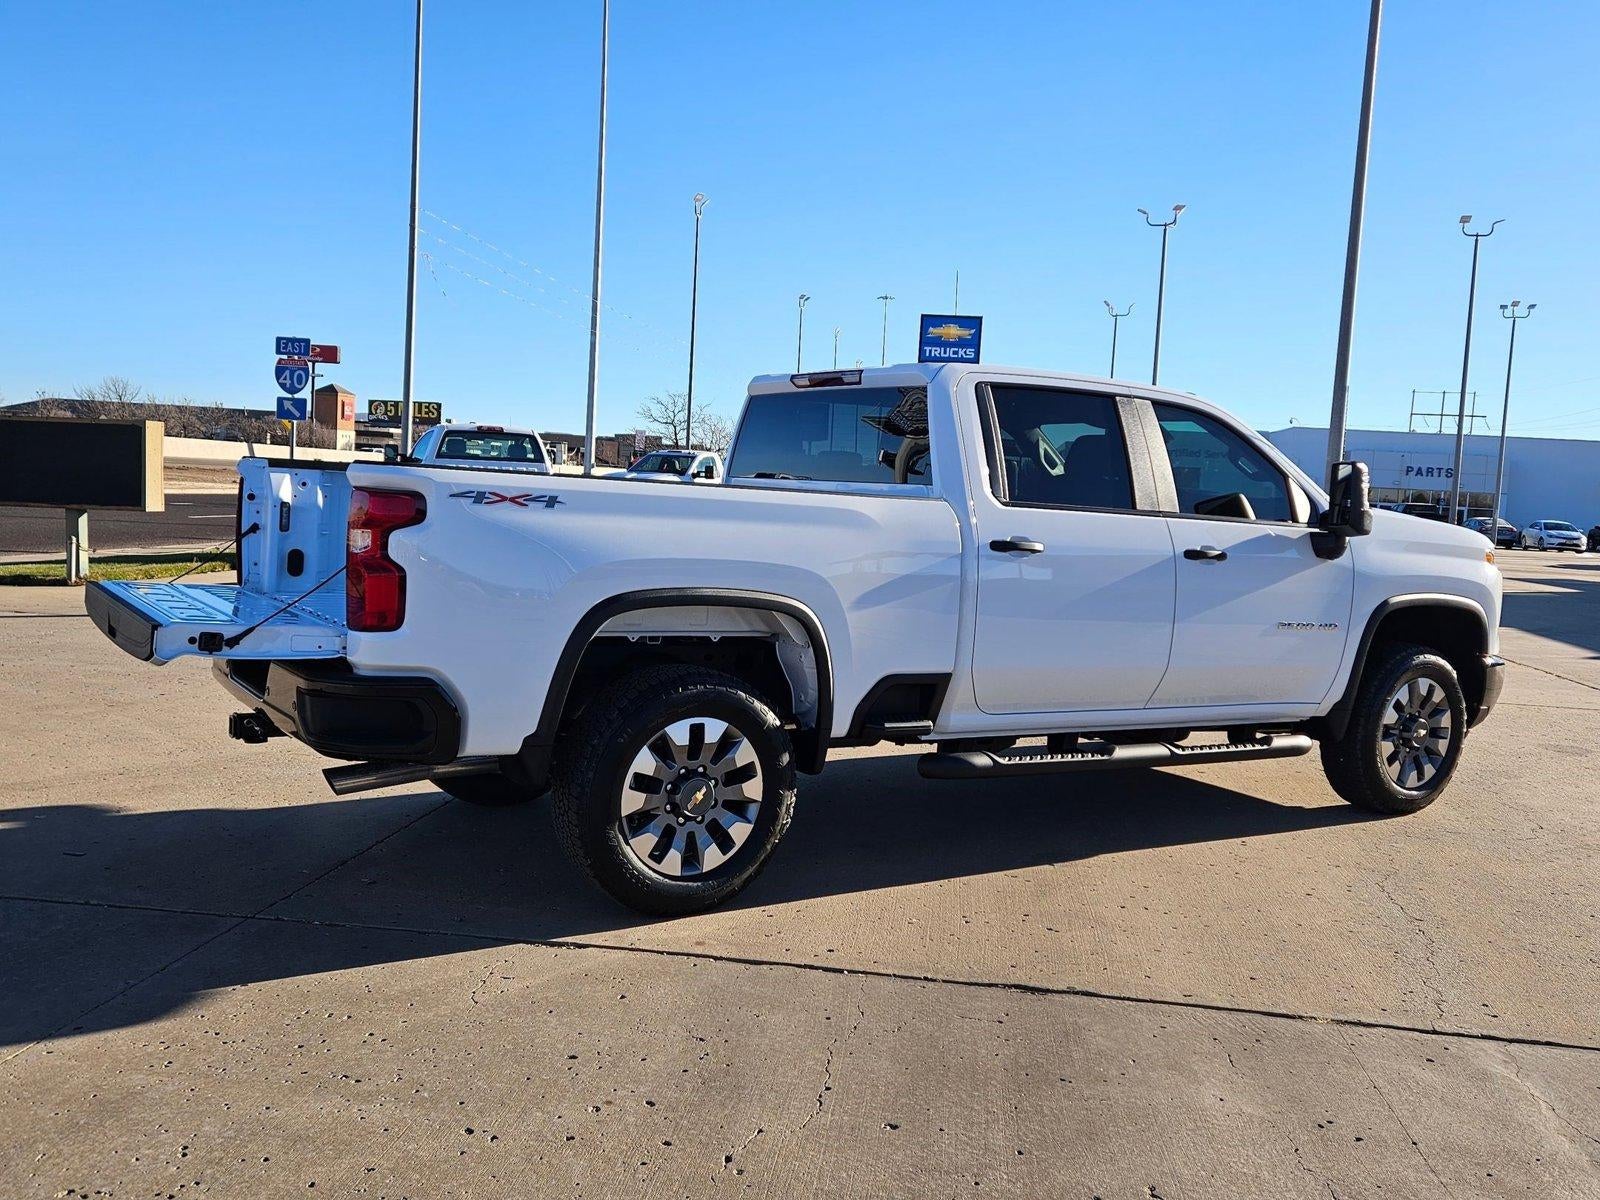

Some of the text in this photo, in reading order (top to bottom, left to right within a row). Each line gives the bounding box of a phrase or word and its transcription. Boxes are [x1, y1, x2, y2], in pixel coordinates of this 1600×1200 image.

[280, 340, 305, 354] EAST
[923, 347, 975, 358] TRUCKS
[278, 370, 306, 389] 40
[386, 401, 395, 416] 5
[1405, 465, 1454, 478] PARTS
[1318, 622, 1339, 631] HD
